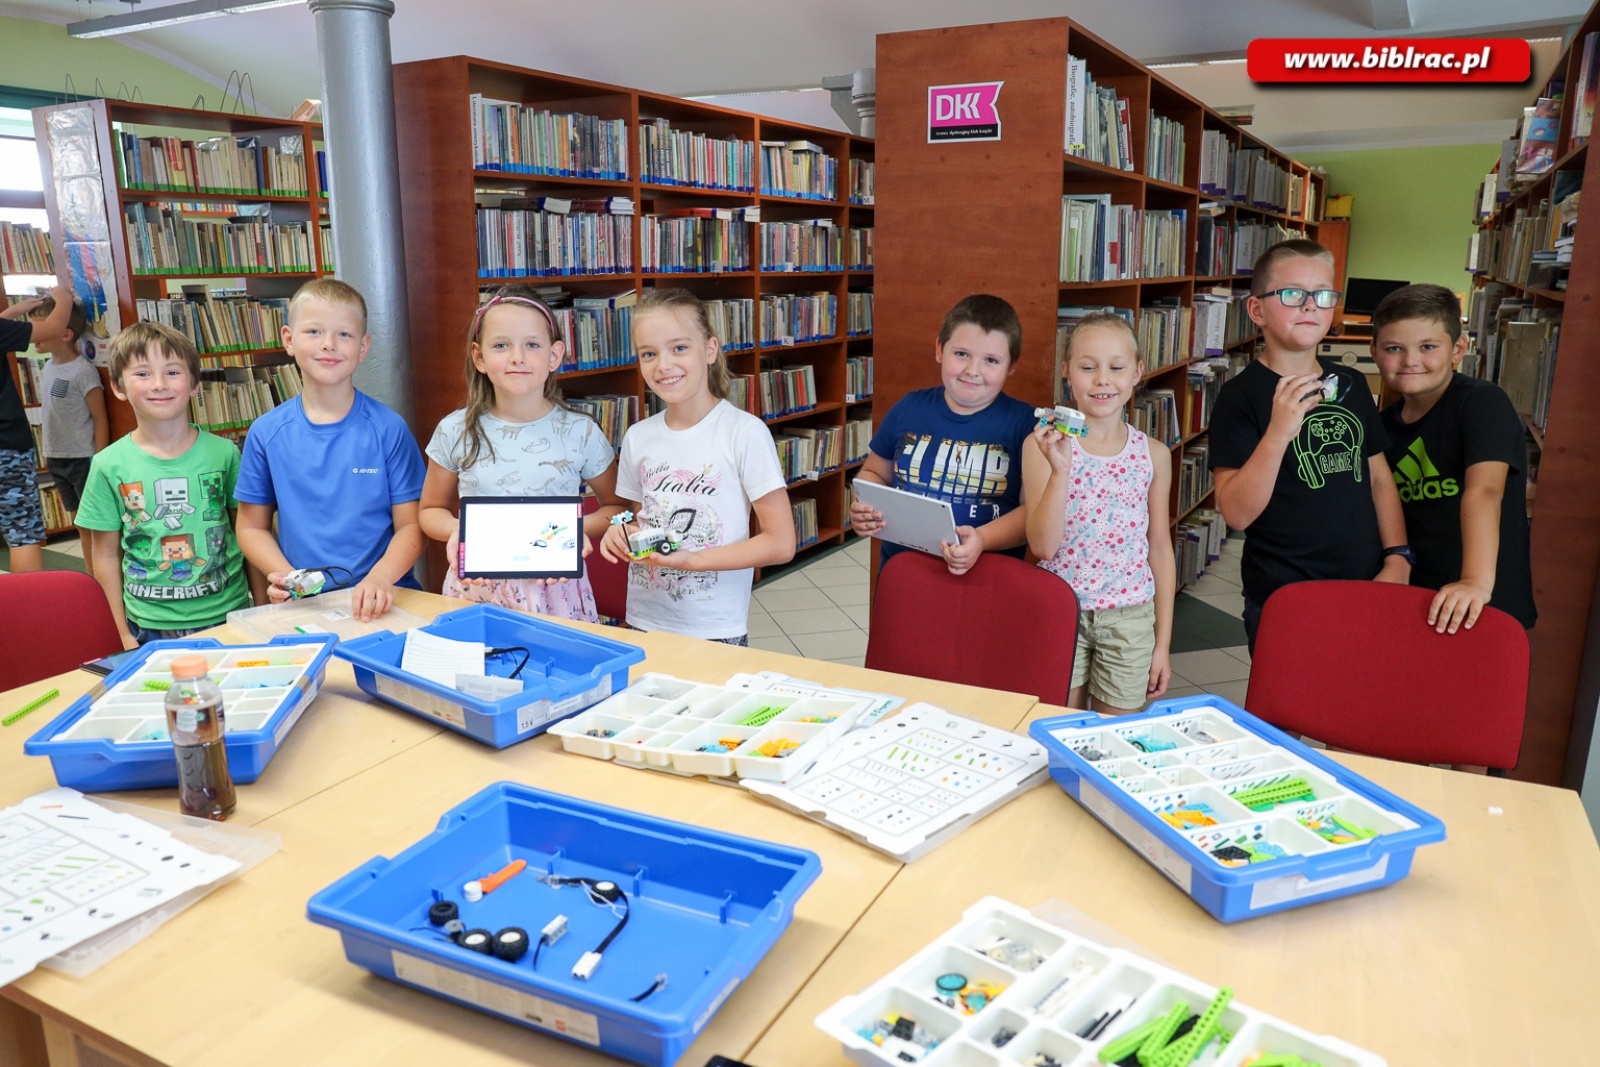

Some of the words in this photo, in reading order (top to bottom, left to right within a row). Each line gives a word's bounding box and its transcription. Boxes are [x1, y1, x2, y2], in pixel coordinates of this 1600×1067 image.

[1320, 451, 1353, 474] GAME
[652, 473, 721, 497] Italia
[1398, 477, 1460, 503] didas
